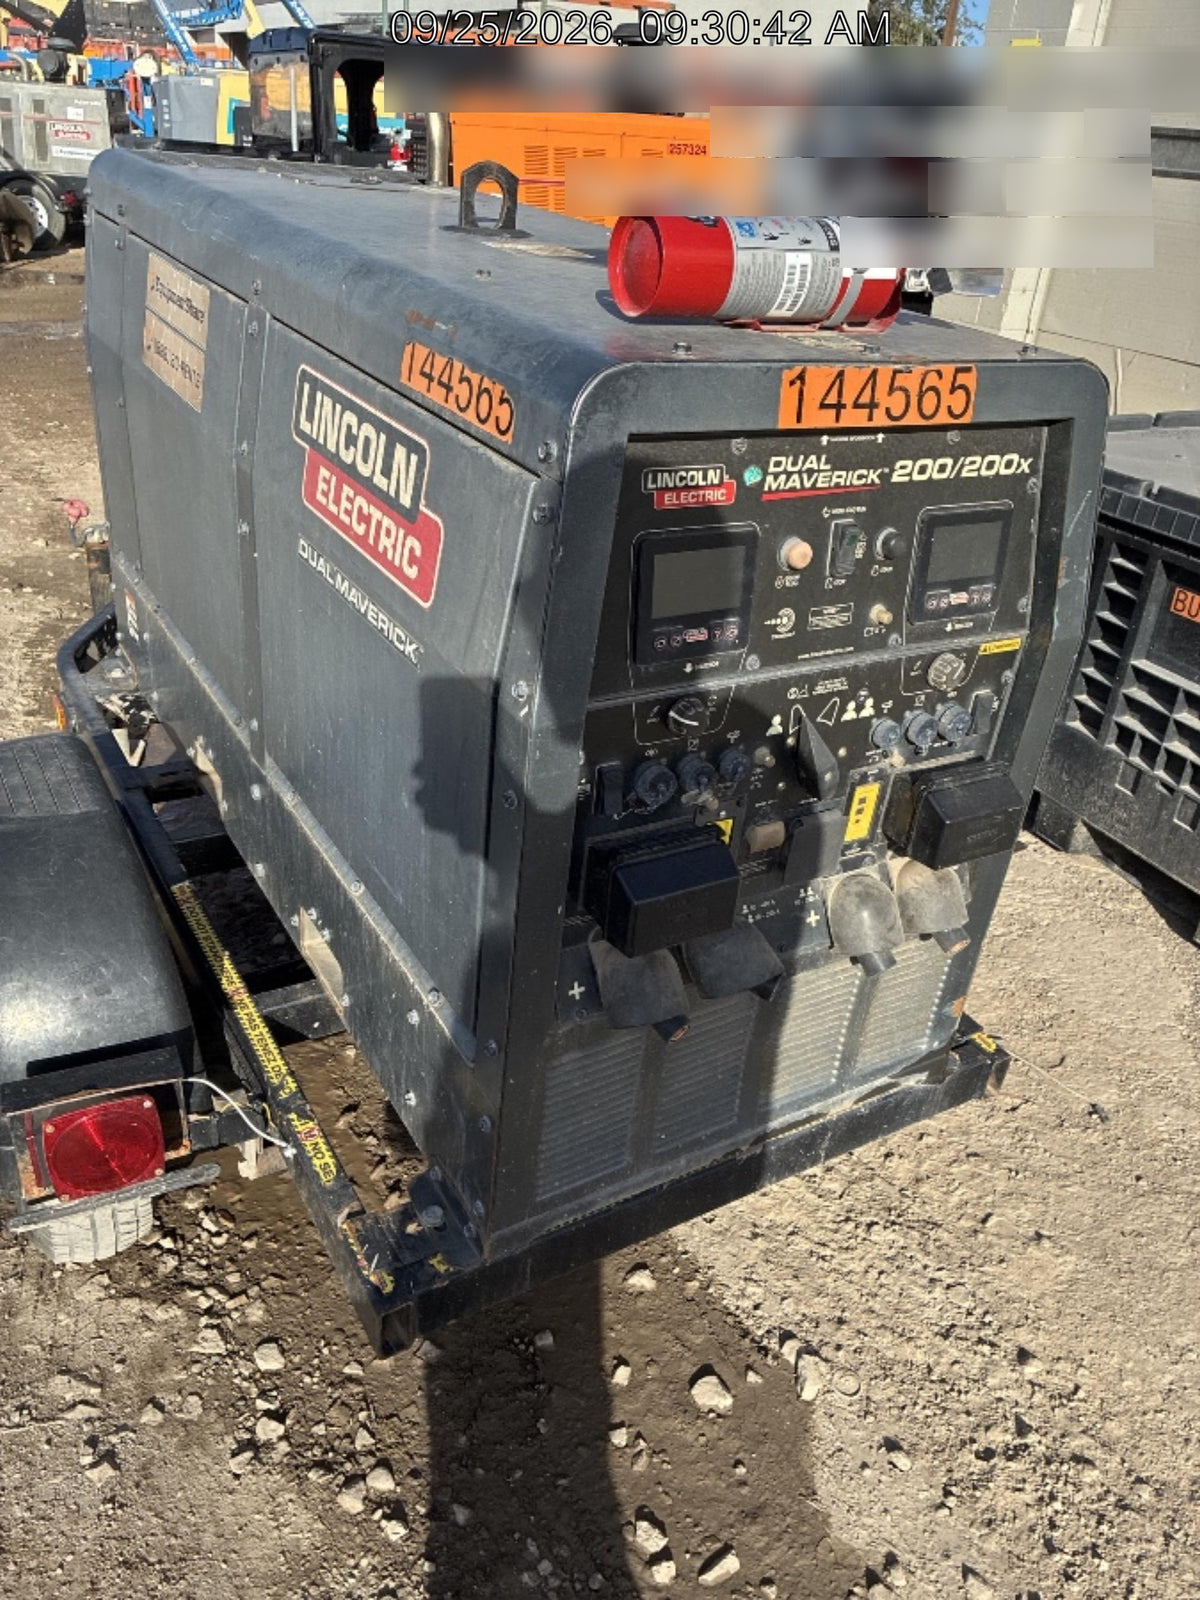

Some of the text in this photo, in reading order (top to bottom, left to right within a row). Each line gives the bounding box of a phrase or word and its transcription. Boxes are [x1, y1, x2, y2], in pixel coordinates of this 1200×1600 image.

[405, 342, 514, 436] 144565
[789, 366, 974, 424] 144565
[299, 382, 418, 509] LINCOLN
[768, 454, 831, 474] DUAL
[646, 469, 721, 489] LINCOLN
[764, 453, 1033, 491] MAVERICK 200/200x
[664, 488, 727, 504] ELECTRIC
[315, 466, 422, 580] ELECTRIC
[298, 537, 419, 664] DUAL MAVERICK
[185, 904, 200, 919] DO
[193, 918, 209, 936] NOT
[244, 1010, 260, 1033] PAS
[253, 1030, 278, 1063] TENEZ
[310, 1142, 326, 1159] NO
